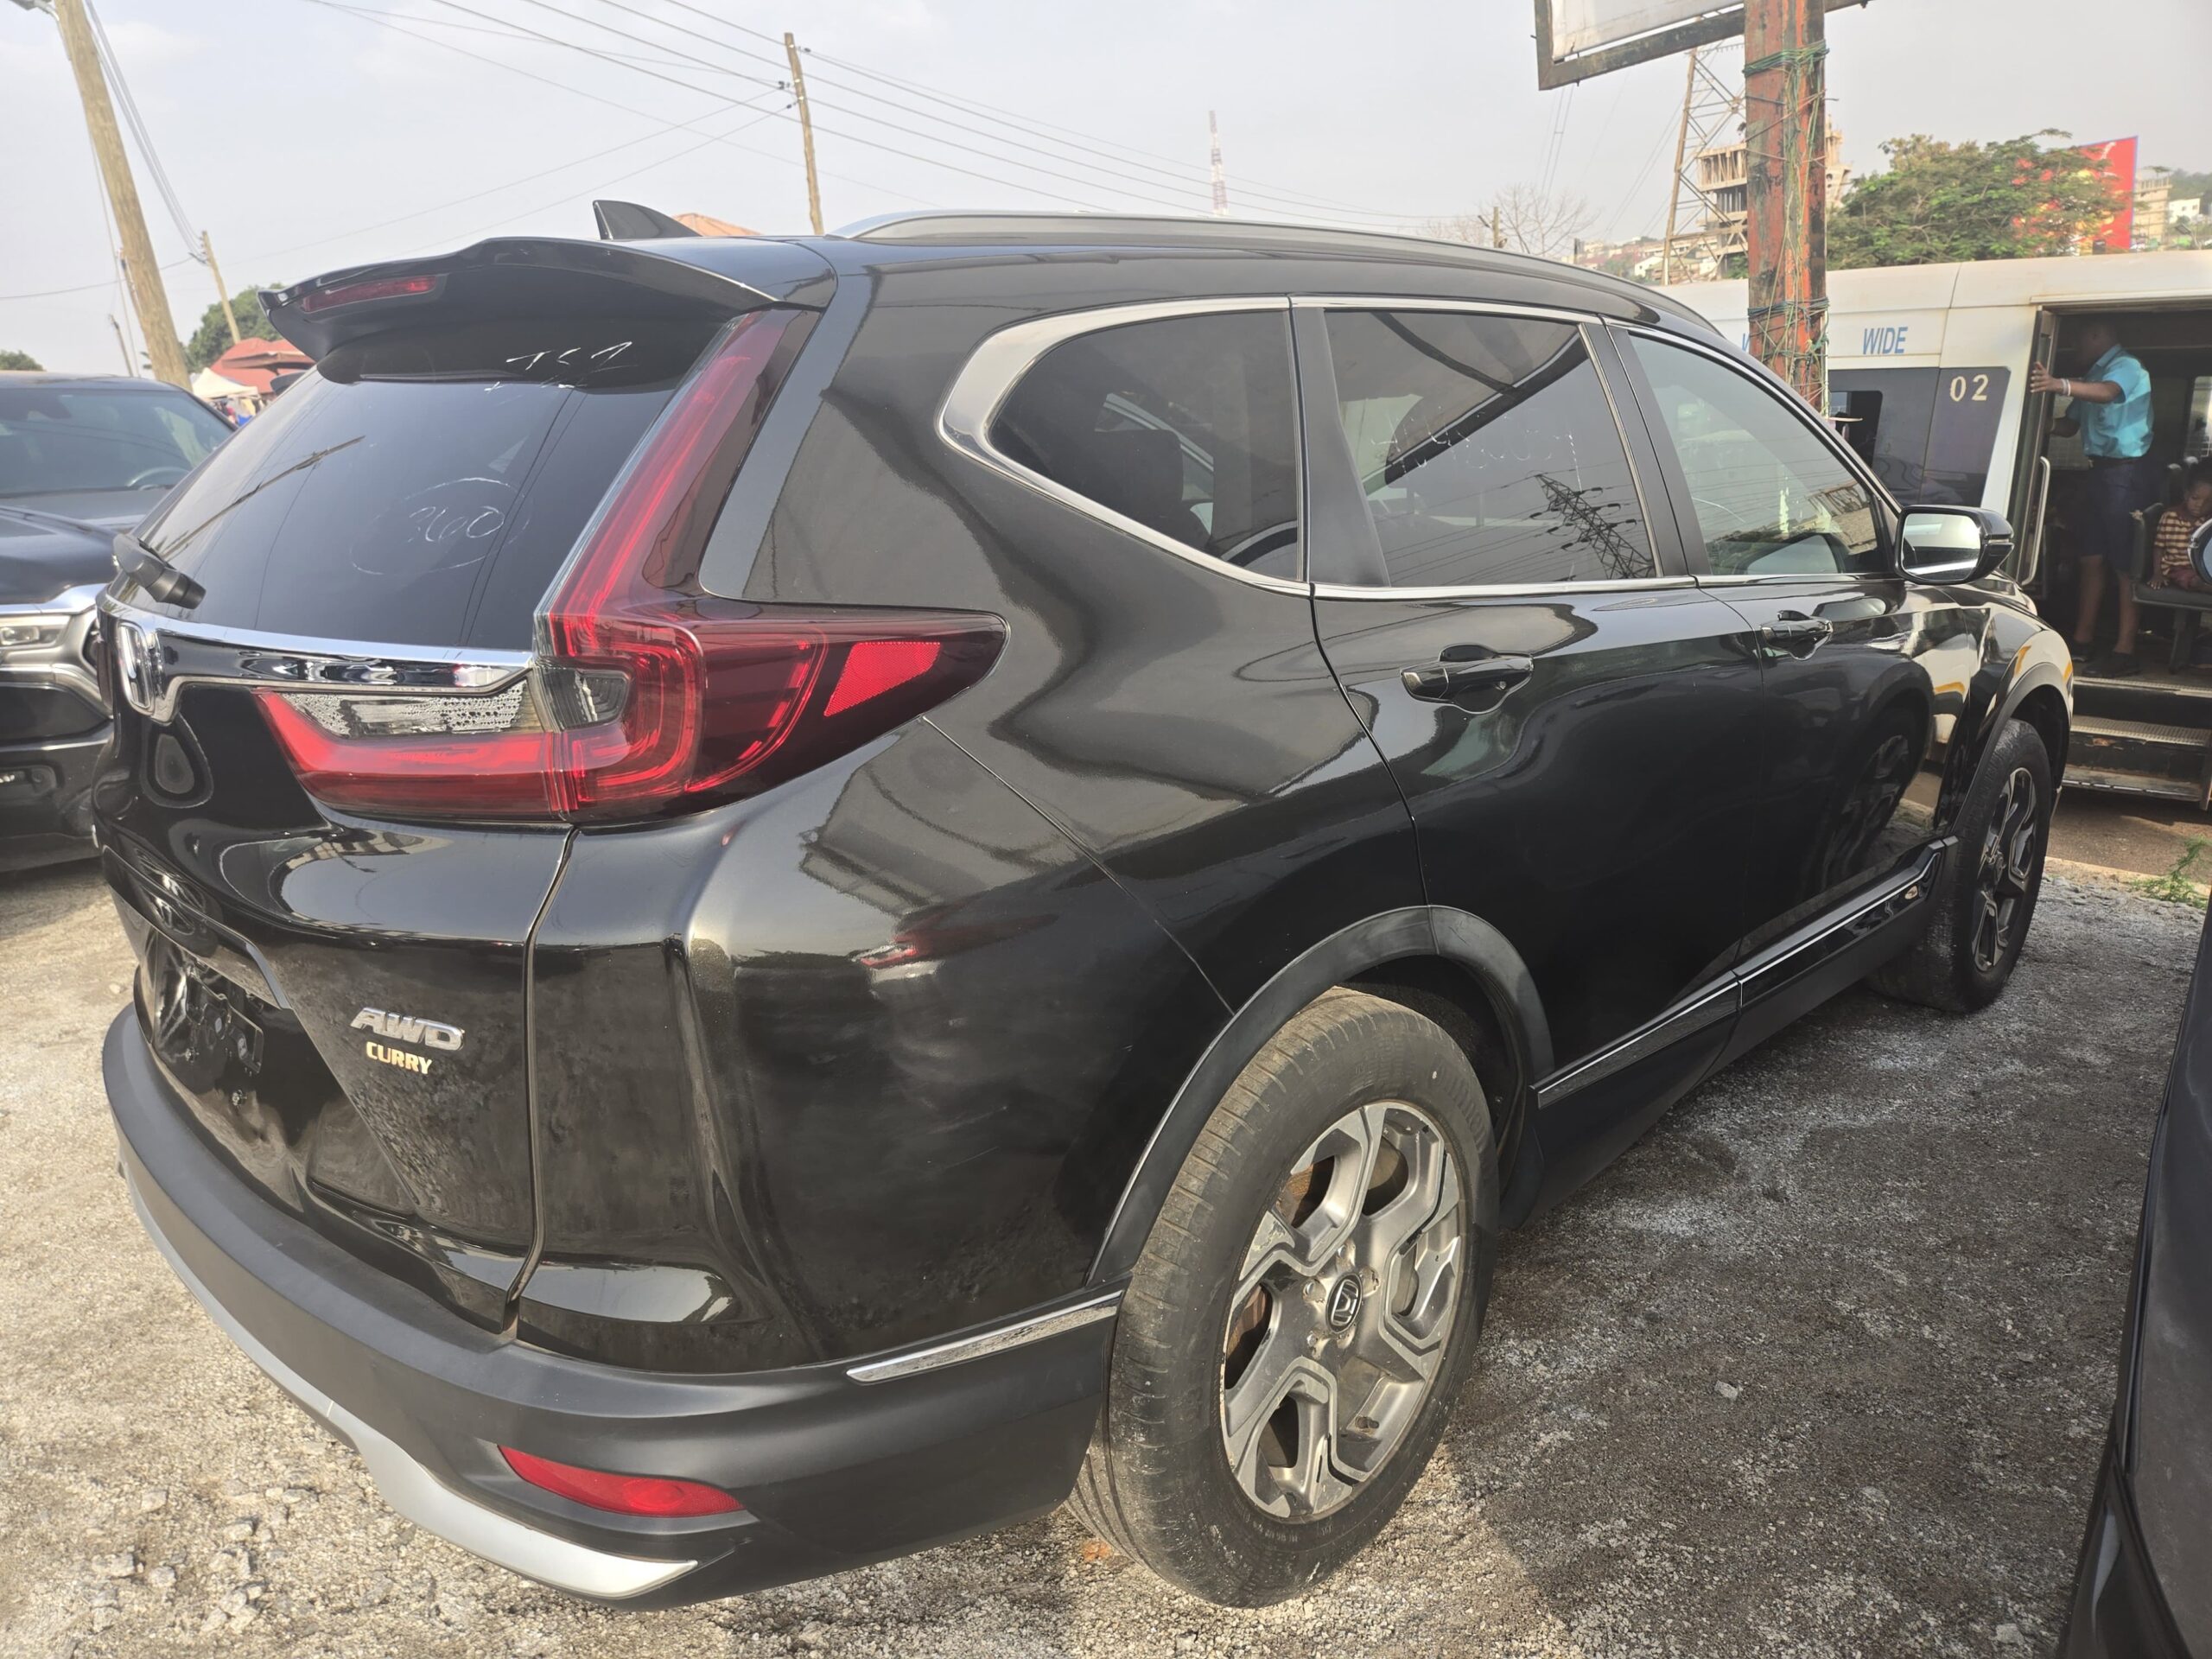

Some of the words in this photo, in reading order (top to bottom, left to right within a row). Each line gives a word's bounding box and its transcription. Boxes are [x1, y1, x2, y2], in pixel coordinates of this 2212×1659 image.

[1862, 326, 1909, 355] WIDE
[350, 1007, 465, 1051] AWD
[365, 1041, 433, 1075] CURRY
